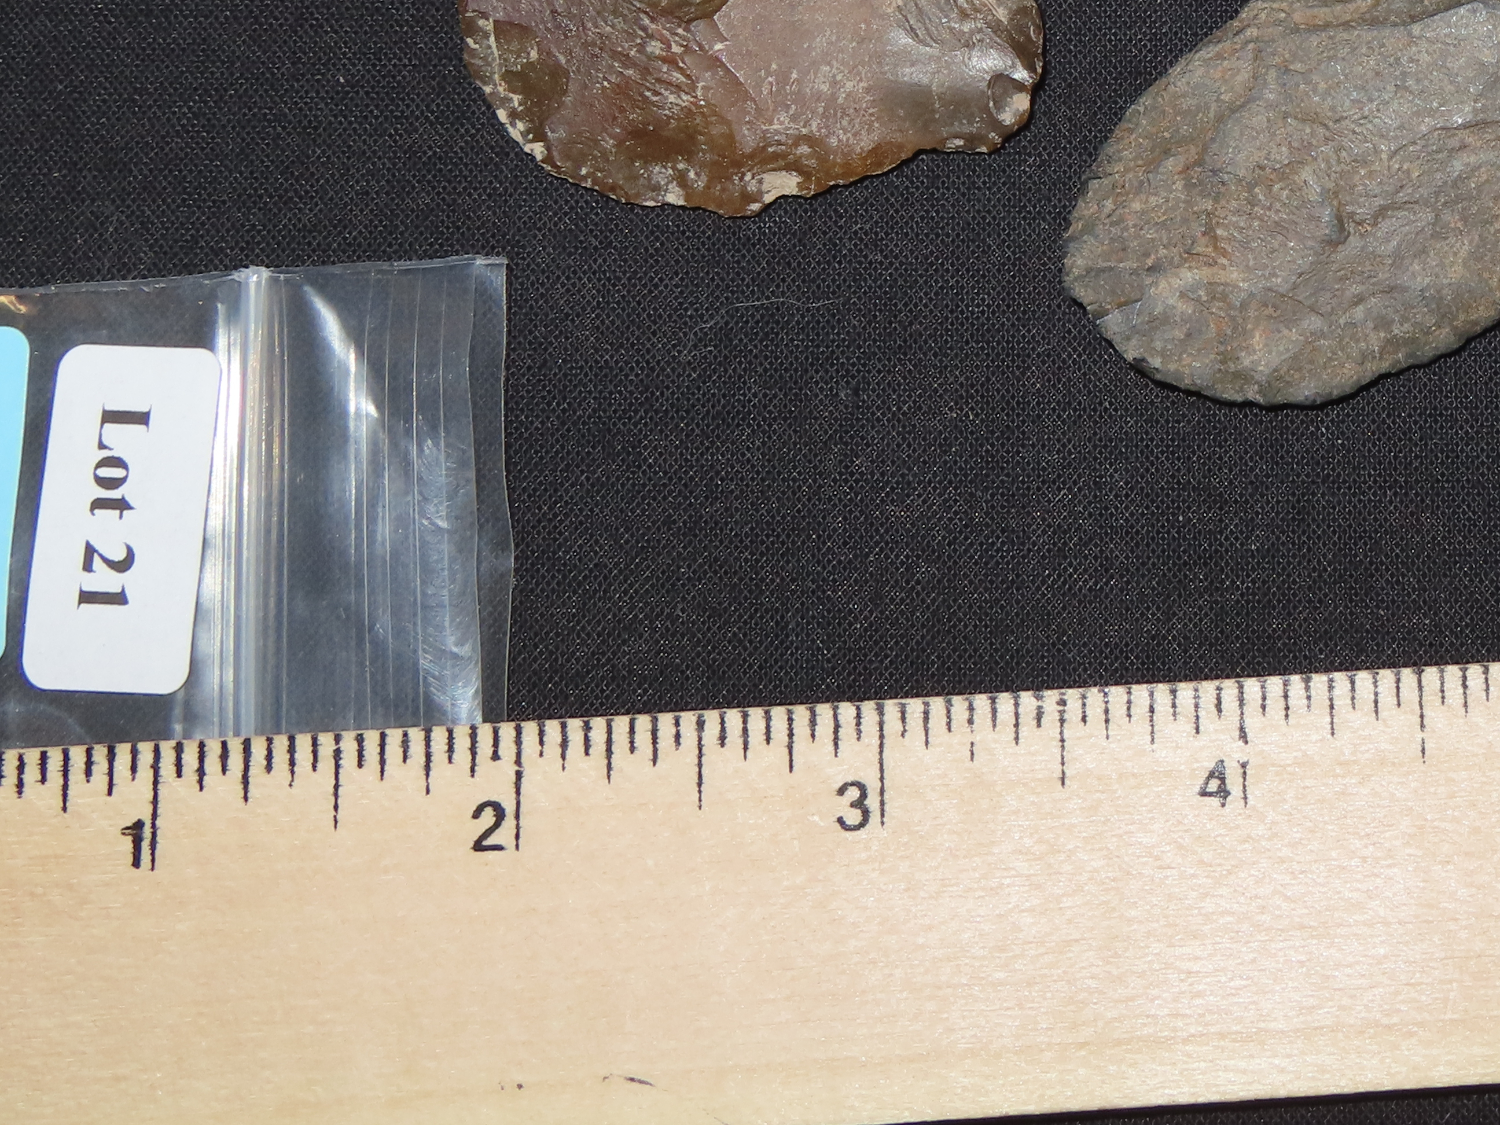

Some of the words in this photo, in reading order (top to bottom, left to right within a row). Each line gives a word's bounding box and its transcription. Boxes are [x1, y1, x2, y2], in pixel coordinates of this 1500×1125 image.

[89, 403, 152, 521] Lot
[77, 541, 136, 610] 21
[121, 819, 145, 869] 1
[471, 800, 506, 852] 2
[837, 781, 870, 831] 3
[1199, 759, 1231, 808] 4
